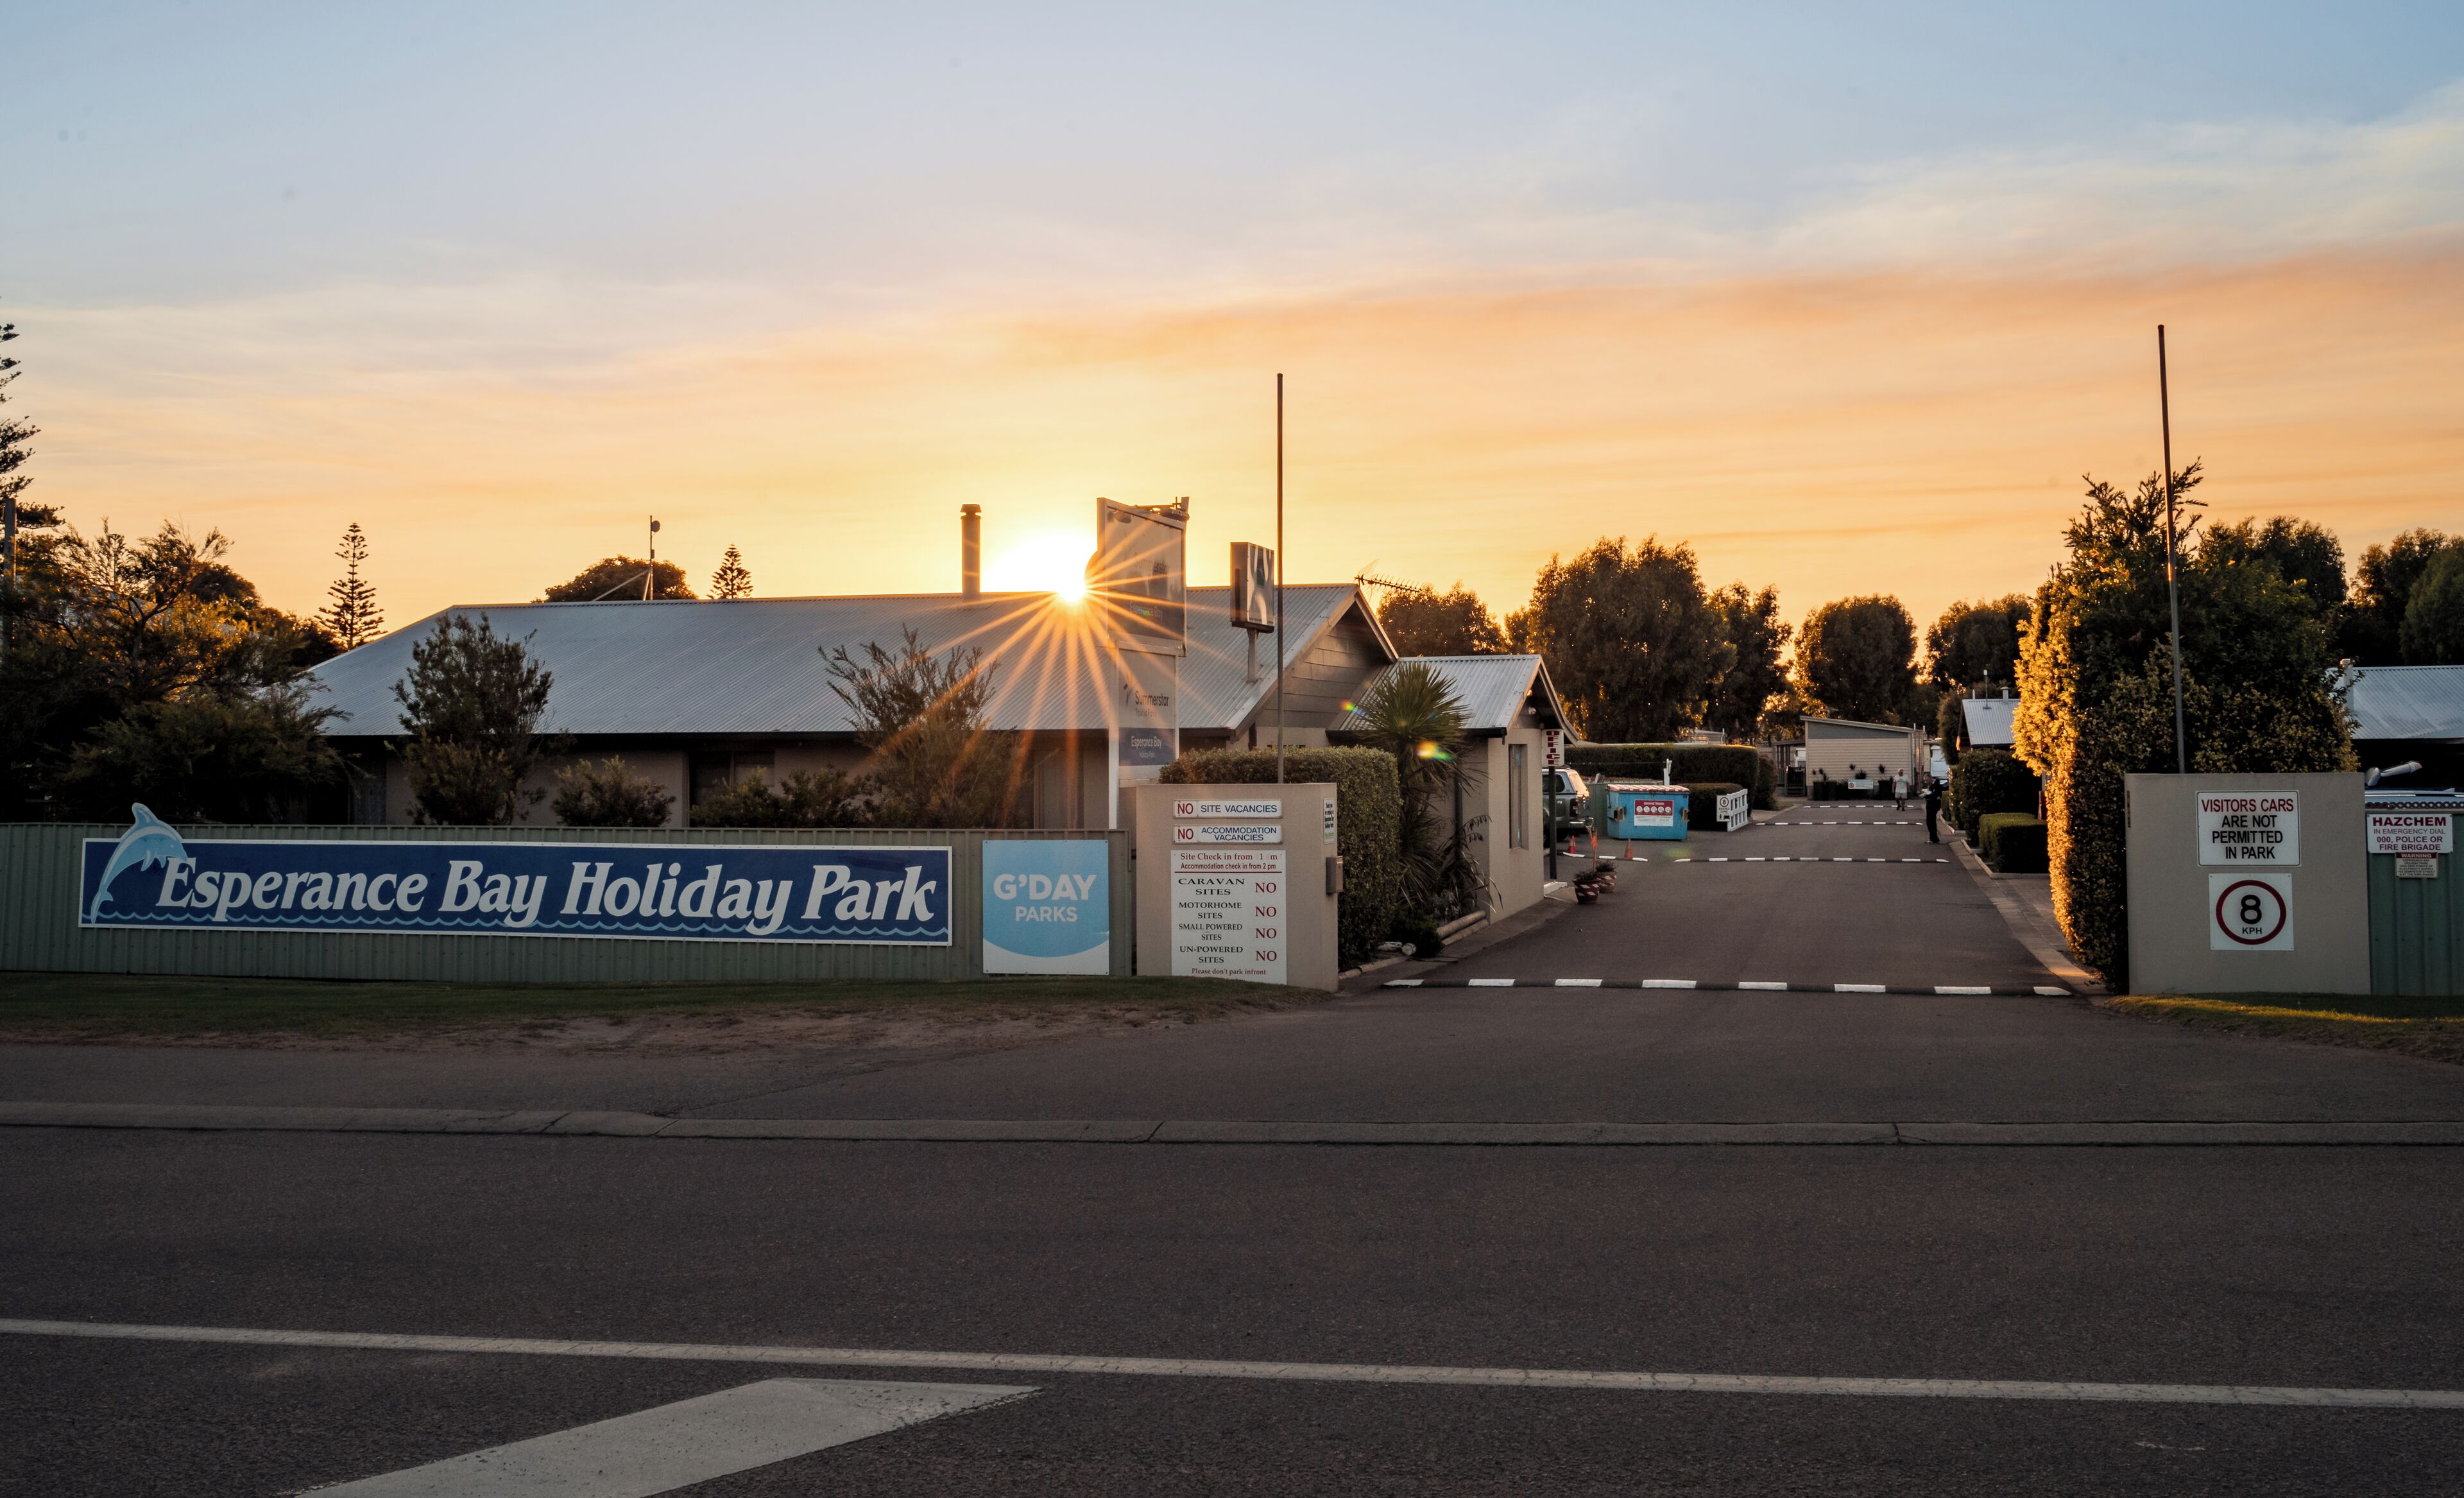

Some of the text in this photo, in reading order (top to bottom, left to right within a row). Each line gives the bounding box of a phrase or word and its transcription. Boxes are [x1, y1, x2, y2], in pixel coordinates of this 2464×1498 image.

[1134, 690, 1169, 707] Summerstar
[1131, 736, 1162, 750] Esperance Bay
[1546, 730, 1560, 764] OFFICE
[1177, 803, 1278, 814] NO SITE VACANCIES
[2201, 798, 2294, 813] VISITORS CARS
[2221, 814, 2277, 828] ARE NOT
[2372, 817, 2446, 827] HAZCHEM
[1177, 828, 1194, 840] NO
[2212, 830, 2283, 844] PERMITTED
[2225, 846, 2276, 859] IN PARK
[993, 874, 1098, 901] G'DAY
[1255, 882, 1277, 893] NO
[155, 857, 937, 935] Esperance Bay Holiday Park
[1015, 906, 1078, 922] PARKS
[1255, 907, 1277, 917] NO
[2240, 893, 2263, 925] 8
[1255, 928, 1277, 939] NO
[2241, 927, 2263, 935] KPH
[1256, 951, 1278, 961] NO
[1229, 968, 1243, 976] park
